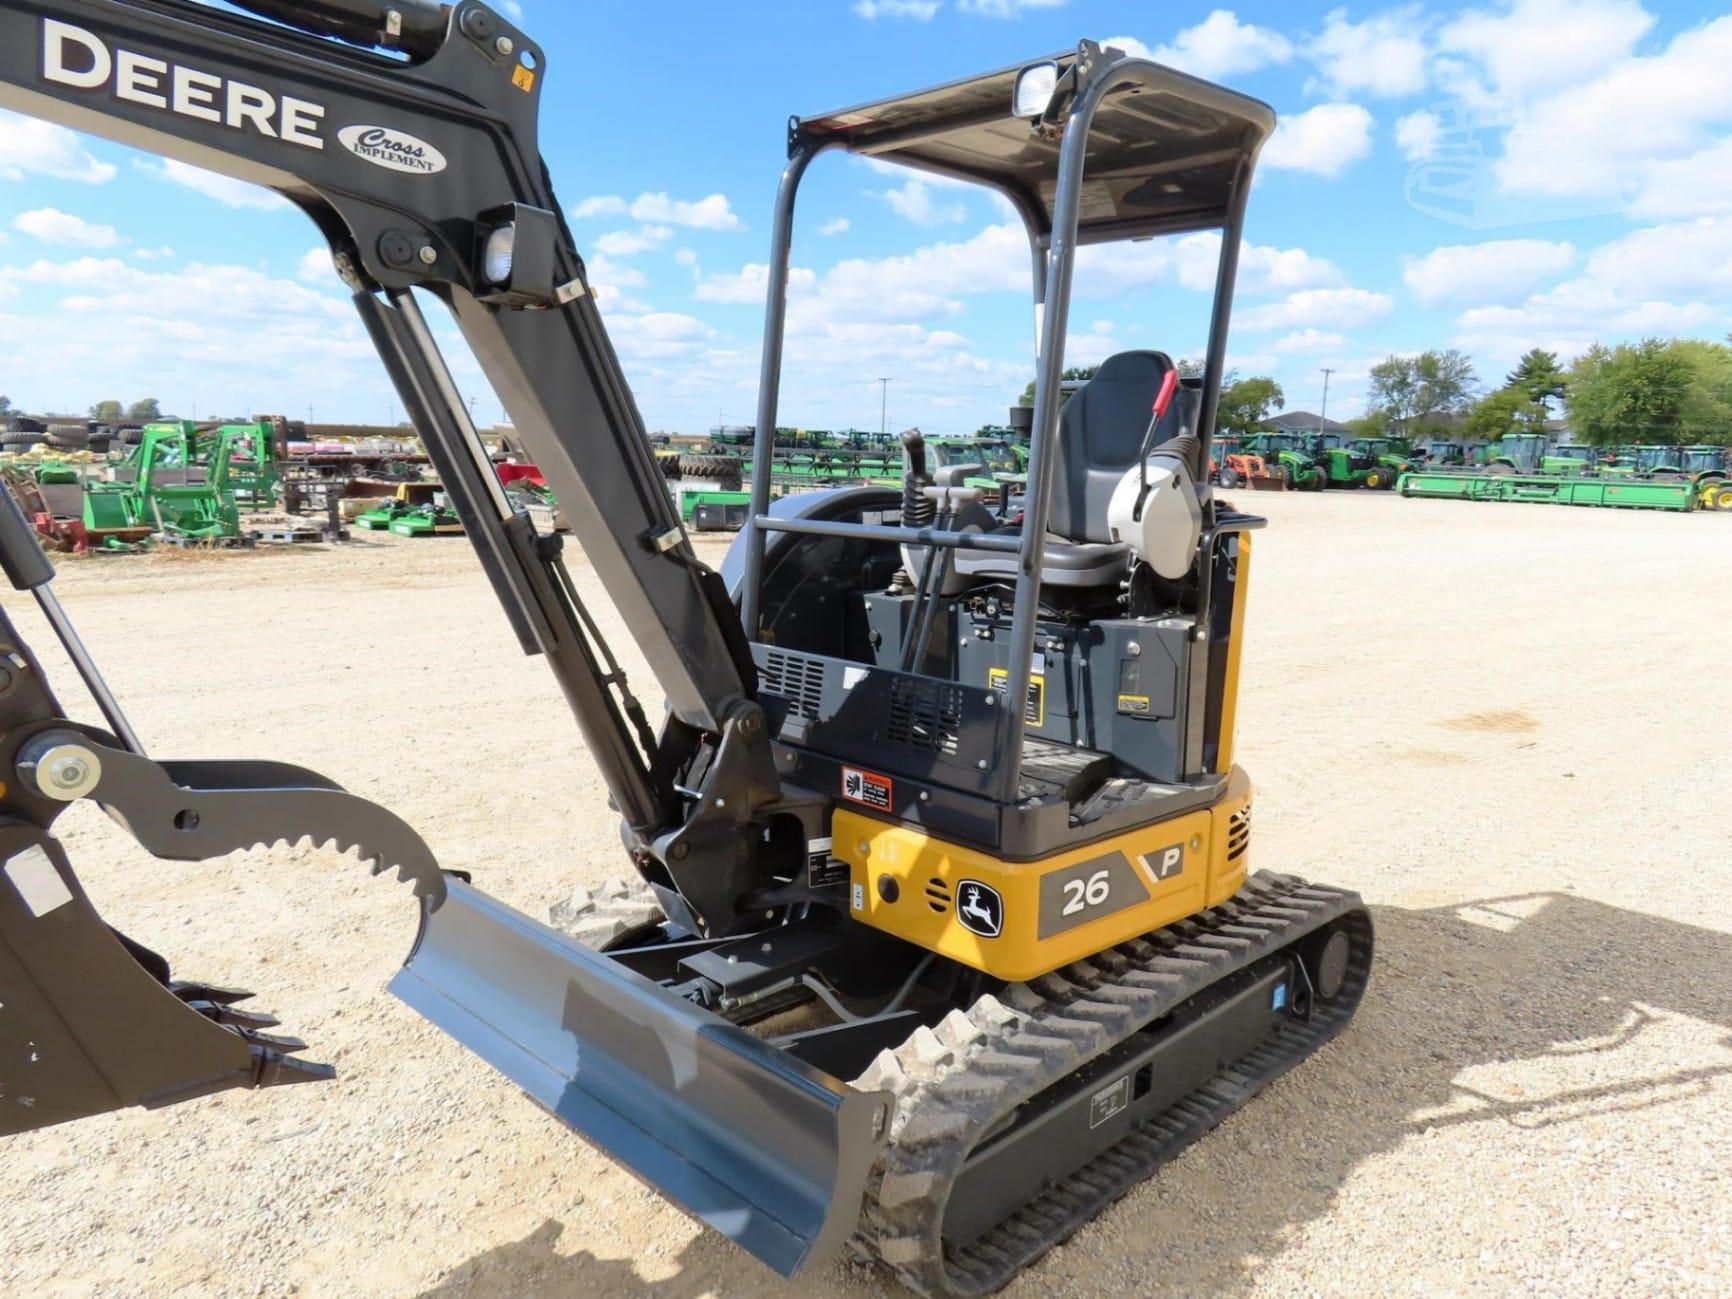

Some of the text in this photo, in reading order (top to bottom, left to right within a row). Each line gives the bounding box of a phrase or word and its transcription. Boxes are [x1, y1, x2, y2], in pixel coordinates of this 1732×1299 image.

[44, 17, 325, 150] DEERE
[353, 143, 435, 171] IMPLEMENT
[357, 129, 426, 157] Cross
[1062, 870, 1110, 917] 26
